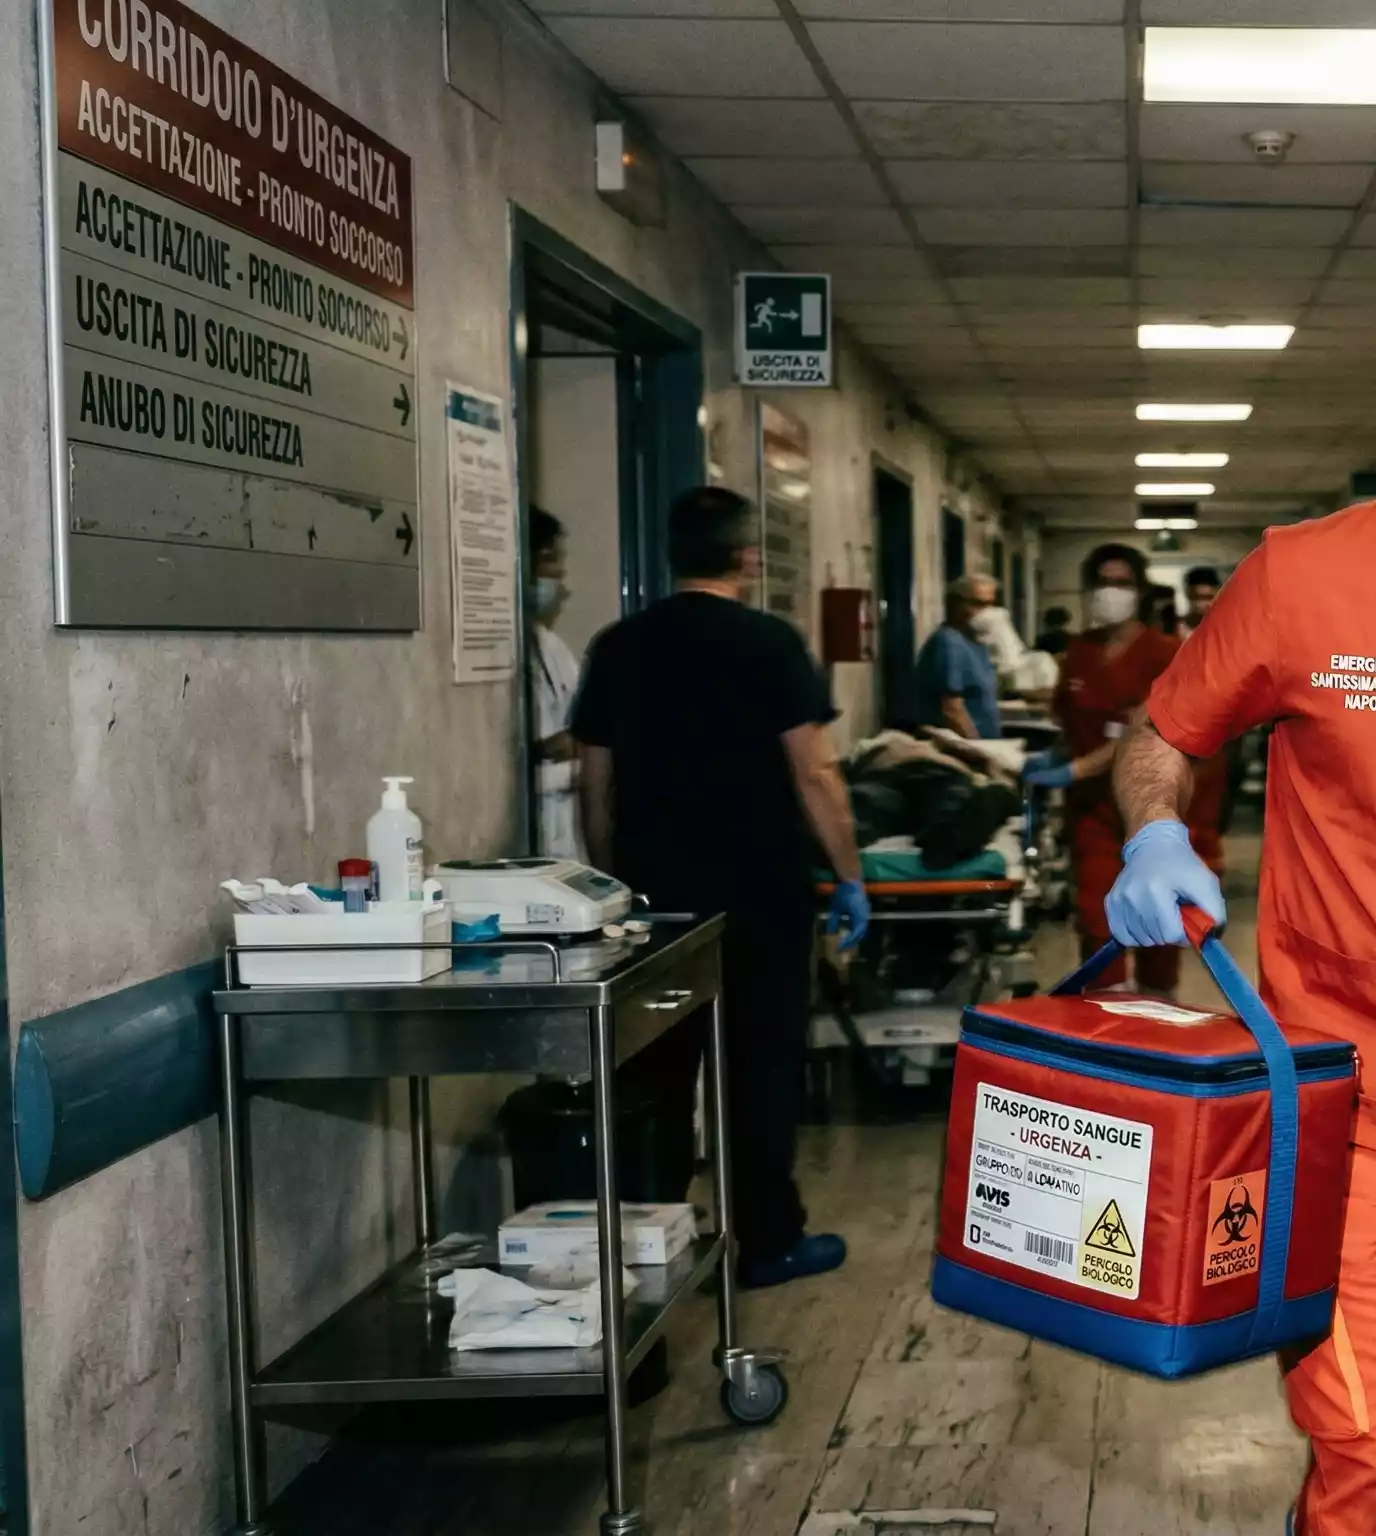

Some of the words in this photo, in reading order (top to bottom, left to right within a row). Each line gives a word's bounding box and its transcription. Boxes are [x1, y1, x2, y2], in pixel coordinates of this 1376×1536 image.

[78, 0, 261, 139] CORRIDOIO
[271, 85, 400, 219] D'URGENZA
[78, 79, 242, 206] ACCETTAZIONE
[259, 171, 324, 247] PRONTO
[329, 210, 403, 286] SOCCORSO
[76, 181, 231, 291] ACCETTAZIONE
[249, 253, 313, 323] PRONTO
[318, 284, 389, 351] SOCCORSO
[76, 275, 167, 352] USCITA
[174, 308, 197, 362] DI
[205, 319, 312, 396] SICUREZZA
[752, 355, 803, 367] USCITA
[807, 355, 820, 367] DI
[80, 370, 165, 438] ANUBO
[173, 393, 195, 445] DI
[202, 401, 304, 467] SICUREZZA
[983, 1093, 1069, 1131] TRASPORTO
[1073, 1118, 1142, 1149] SANGUE
[1020, 1126, 1092, 1161] URGENZA
[975, 1182, 1010, 1207] AVIS
